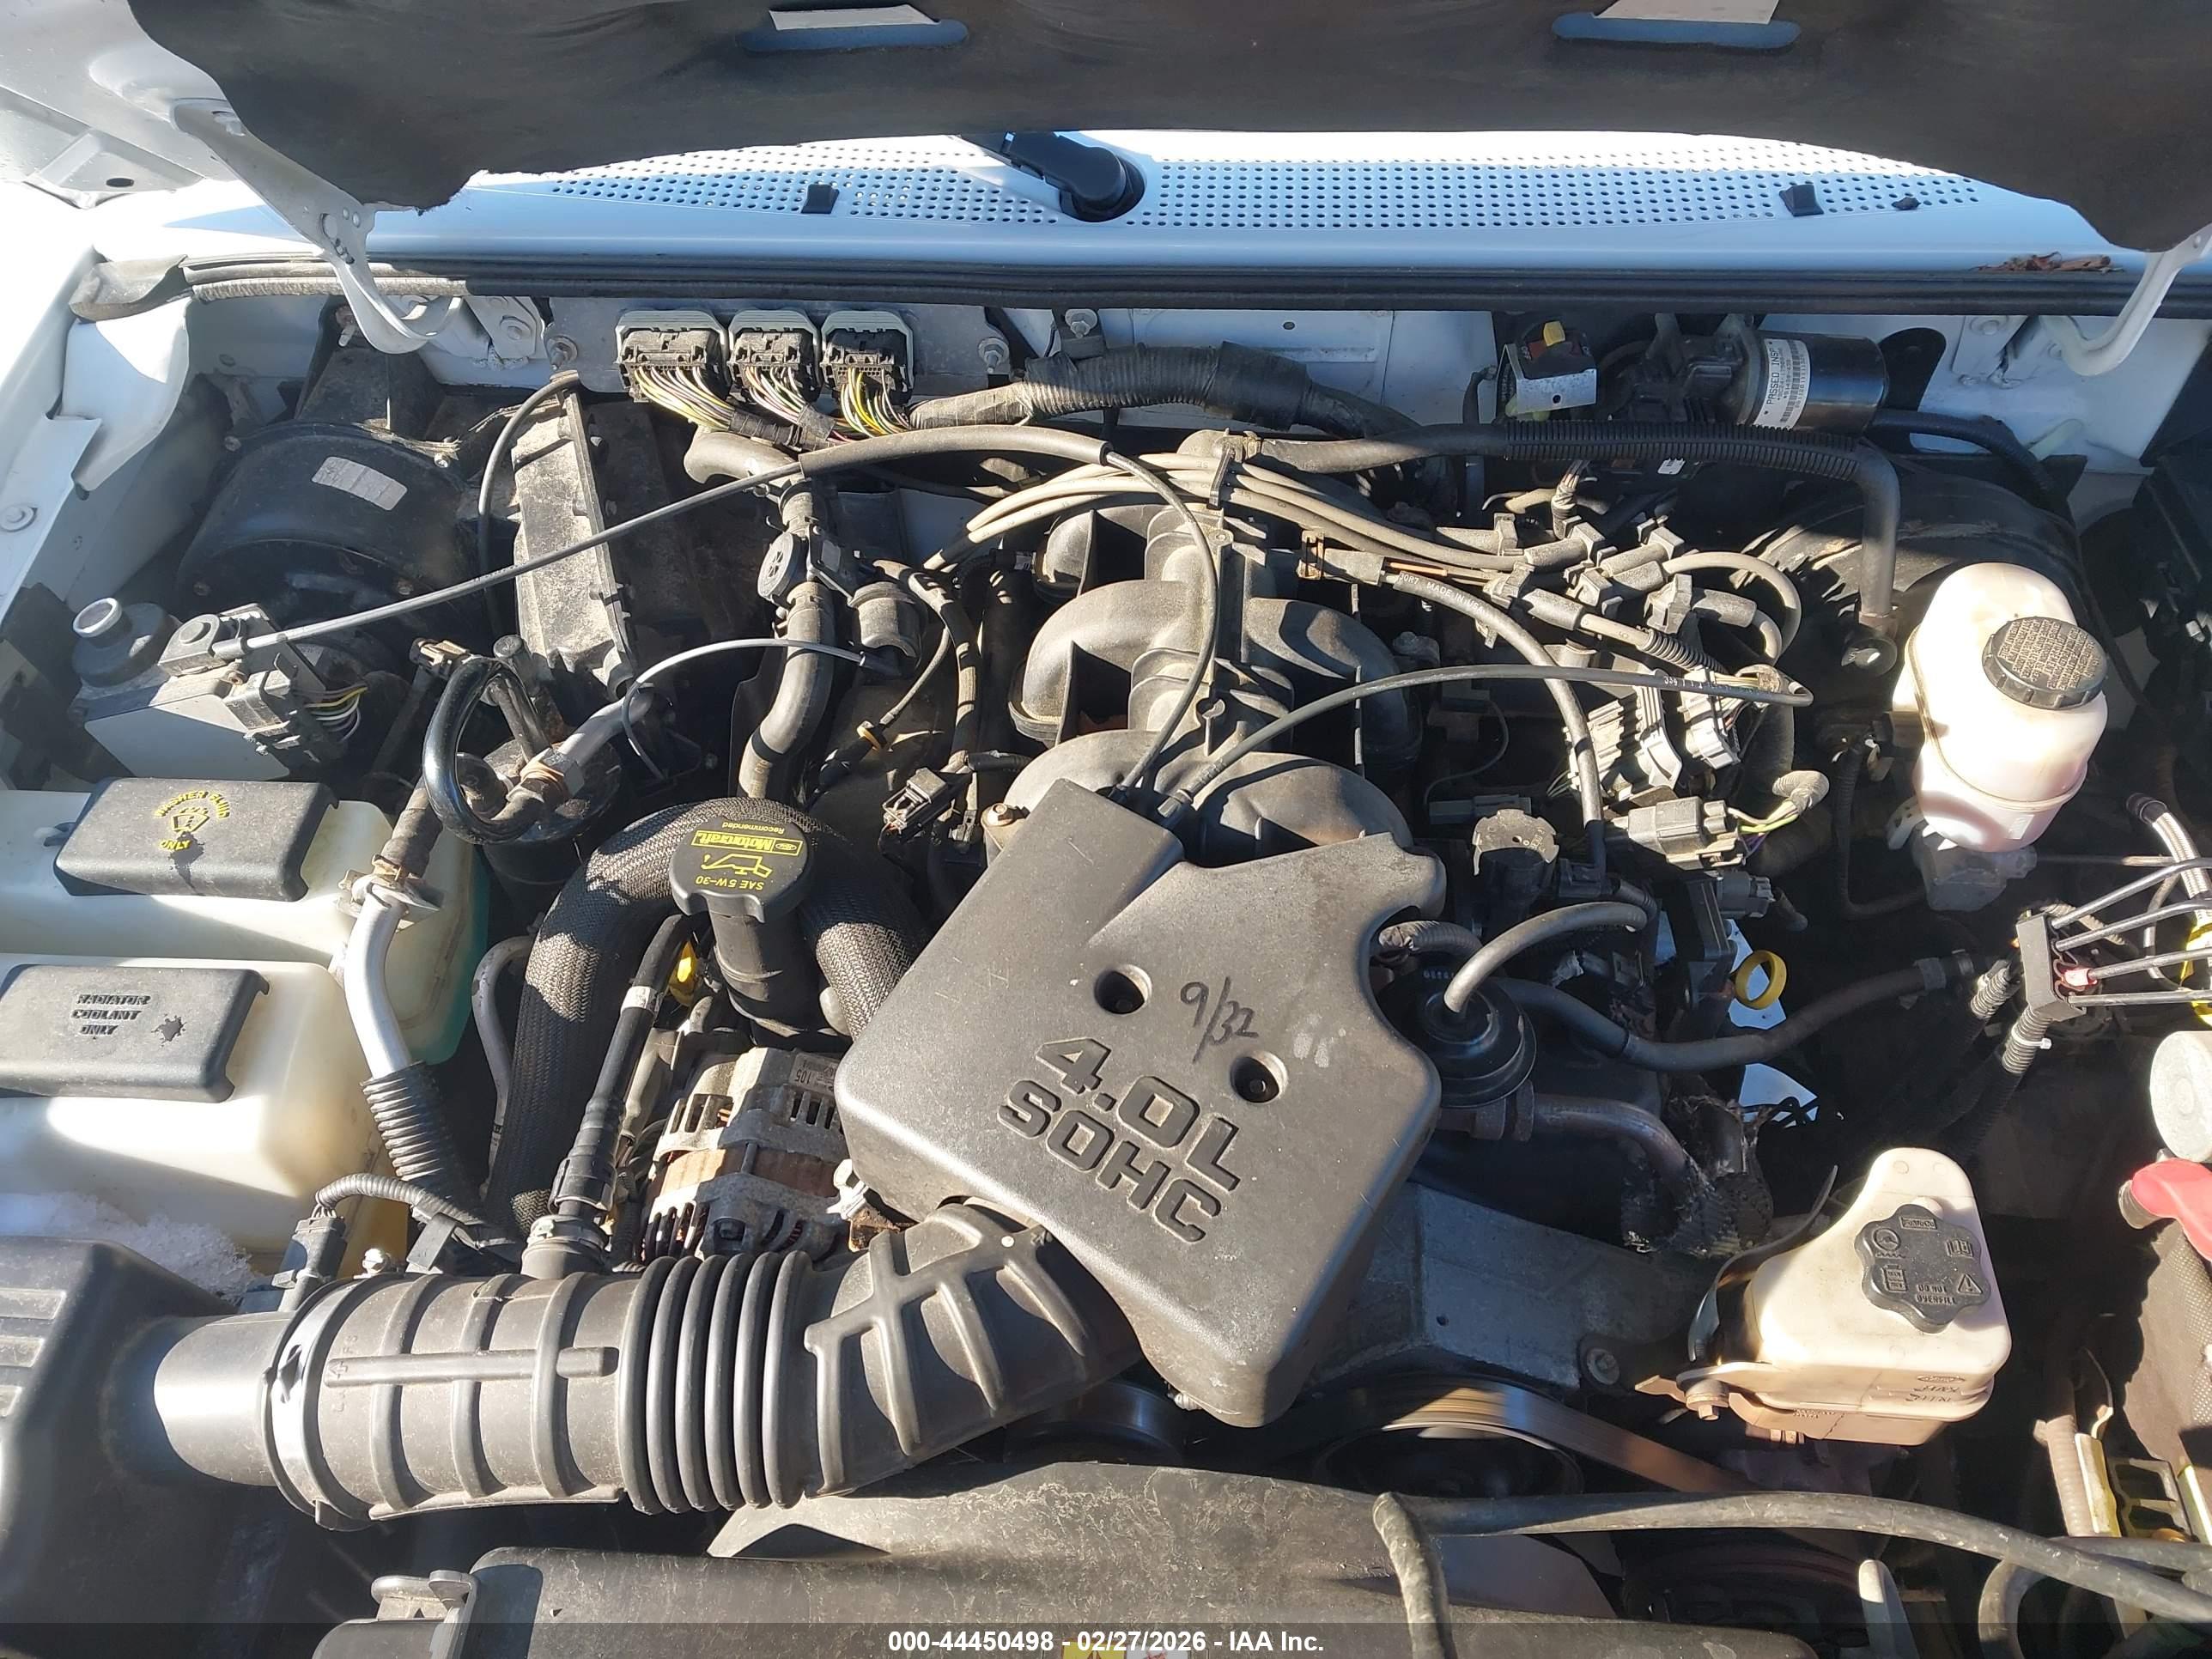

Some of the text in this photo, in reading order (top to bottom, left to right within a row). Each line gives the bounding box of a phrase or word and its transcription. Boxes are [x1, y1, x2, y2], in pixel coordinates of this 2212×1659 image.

[1766, 373, 1780, 405] PASSED
[1426, 581, 1452, 598] MADE
[1455, 592, 1465, 602] IN
[154, 791, 230, 818] WASHER FLUID
[722, 822, 785, 835] Recommended
[160, 840, 191, 850] ONLY
[696, 875, 764, 890] SAE 5W-30
[76, 994, 151, 1006] RADIATOR
[70, 1009, 143, 1020] COOLANT
[80, 1024, 119, 1035] ONLY
[1035, 1036, 1242, 1193] 4.0L
[997, 1079, 1223, 1244] SOHC
